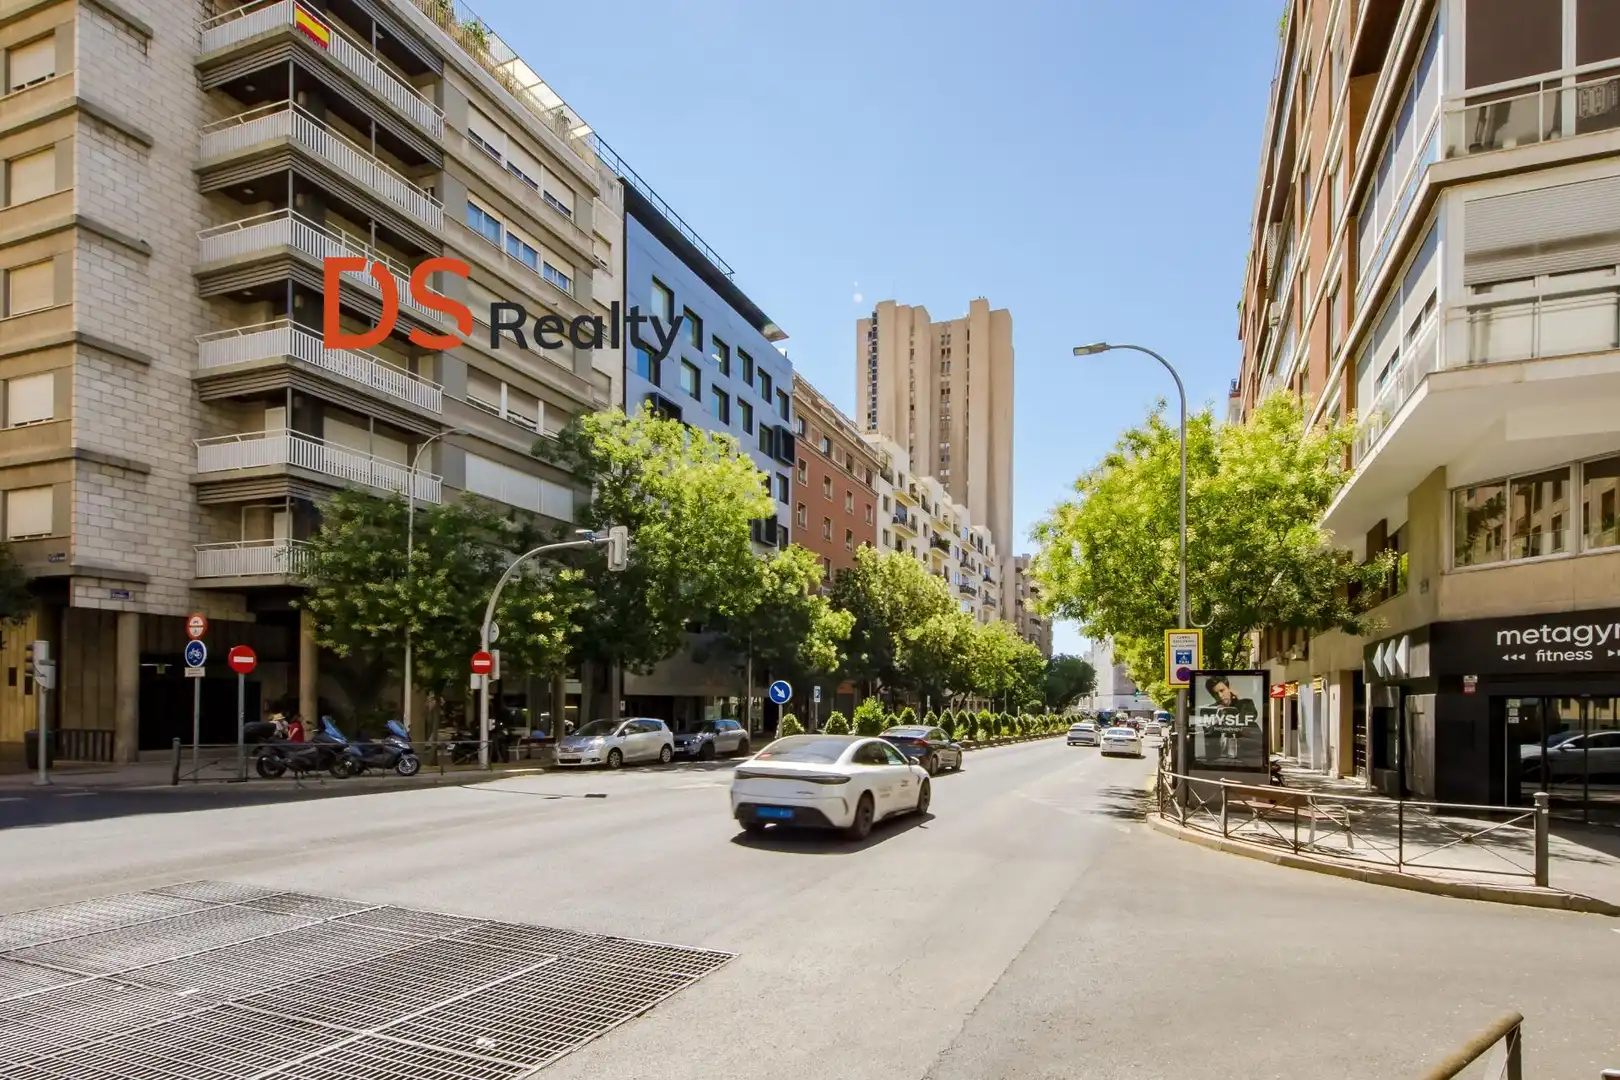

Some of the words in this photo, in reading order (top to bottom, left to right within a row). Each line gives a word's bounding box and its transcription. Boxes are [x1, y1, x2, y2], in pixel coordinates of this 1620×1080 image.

[1496, 623, 1620, 647] metagy
[1536, 649, 1593, 662] fitness
[1203, 714, 1254, 726] MYSLF
